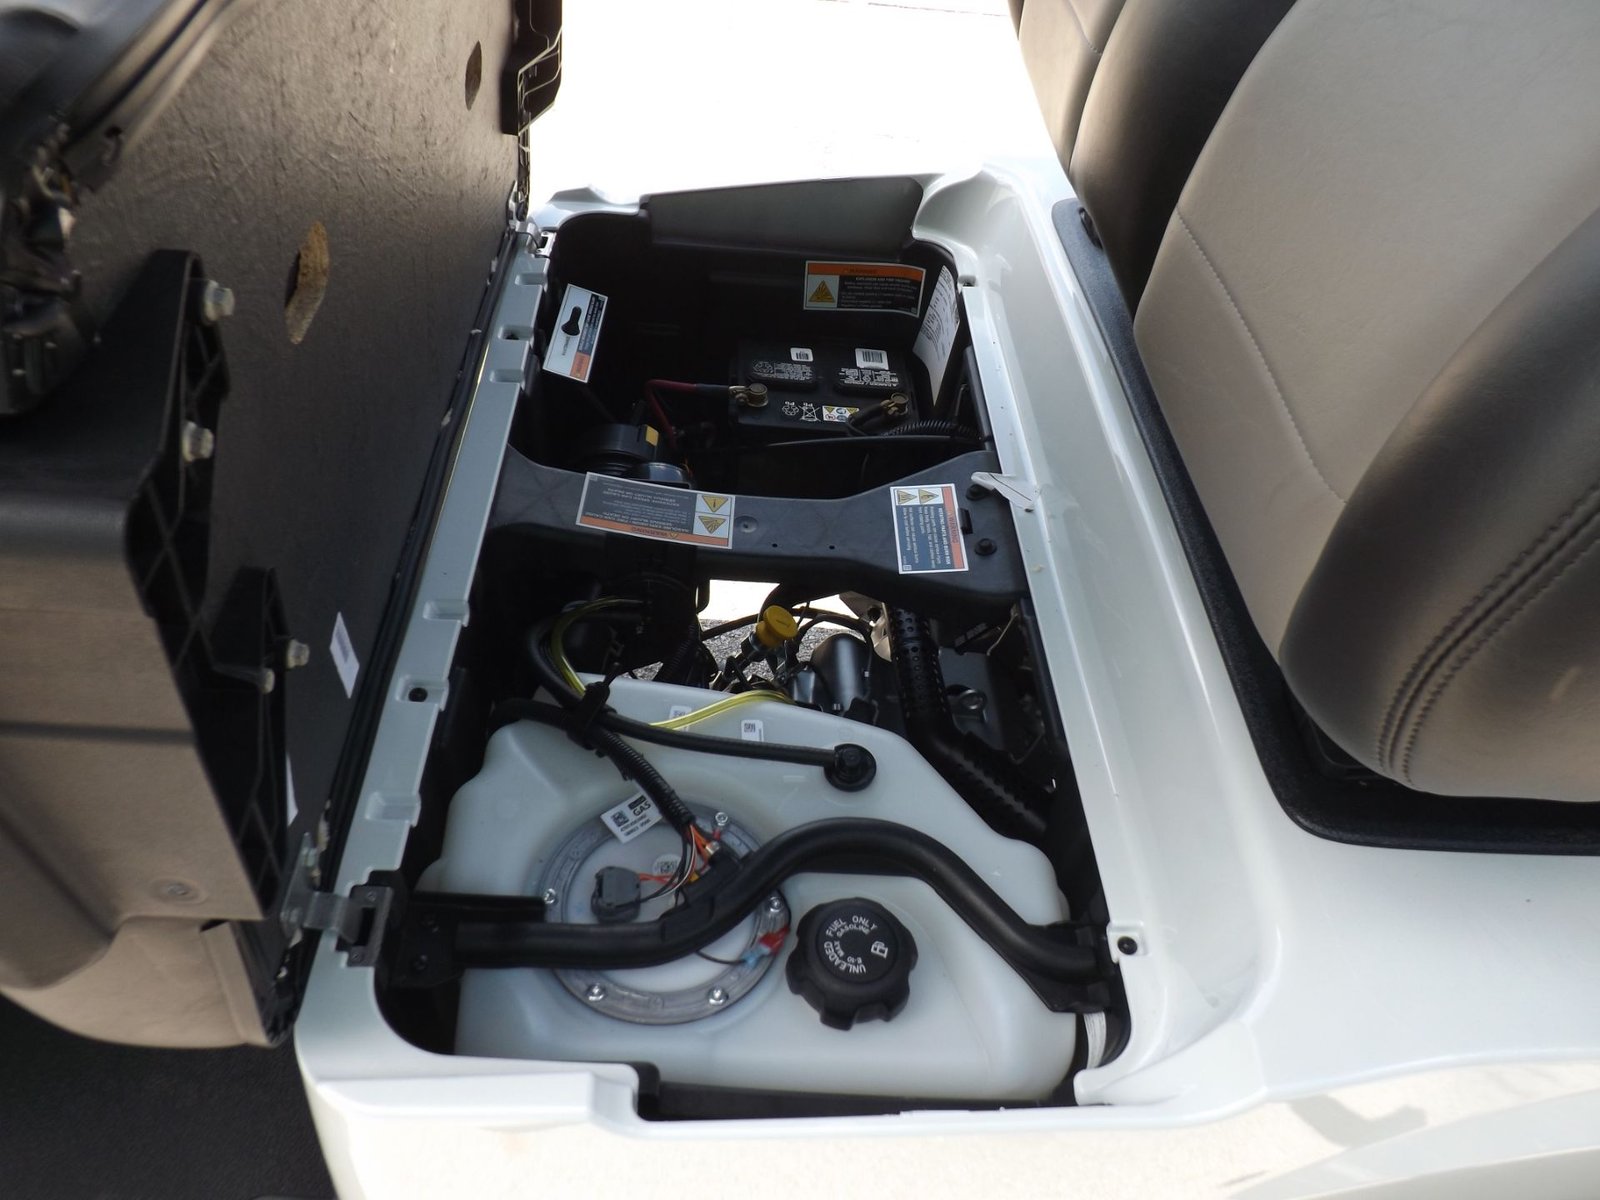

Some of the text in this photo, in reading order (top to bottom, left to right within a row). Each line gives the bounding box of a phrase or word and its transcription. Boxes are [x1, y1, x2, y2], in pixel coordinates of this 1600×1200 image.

[631, 527, 668, 537] WARNING
[948, 517, 959, 543] WARNING
[633, 801, 651, 816] GAS
[836, 924, 871, 938] GASOLINE
[824, 915, 878, 974] UNLEADED FUEL ONLY
